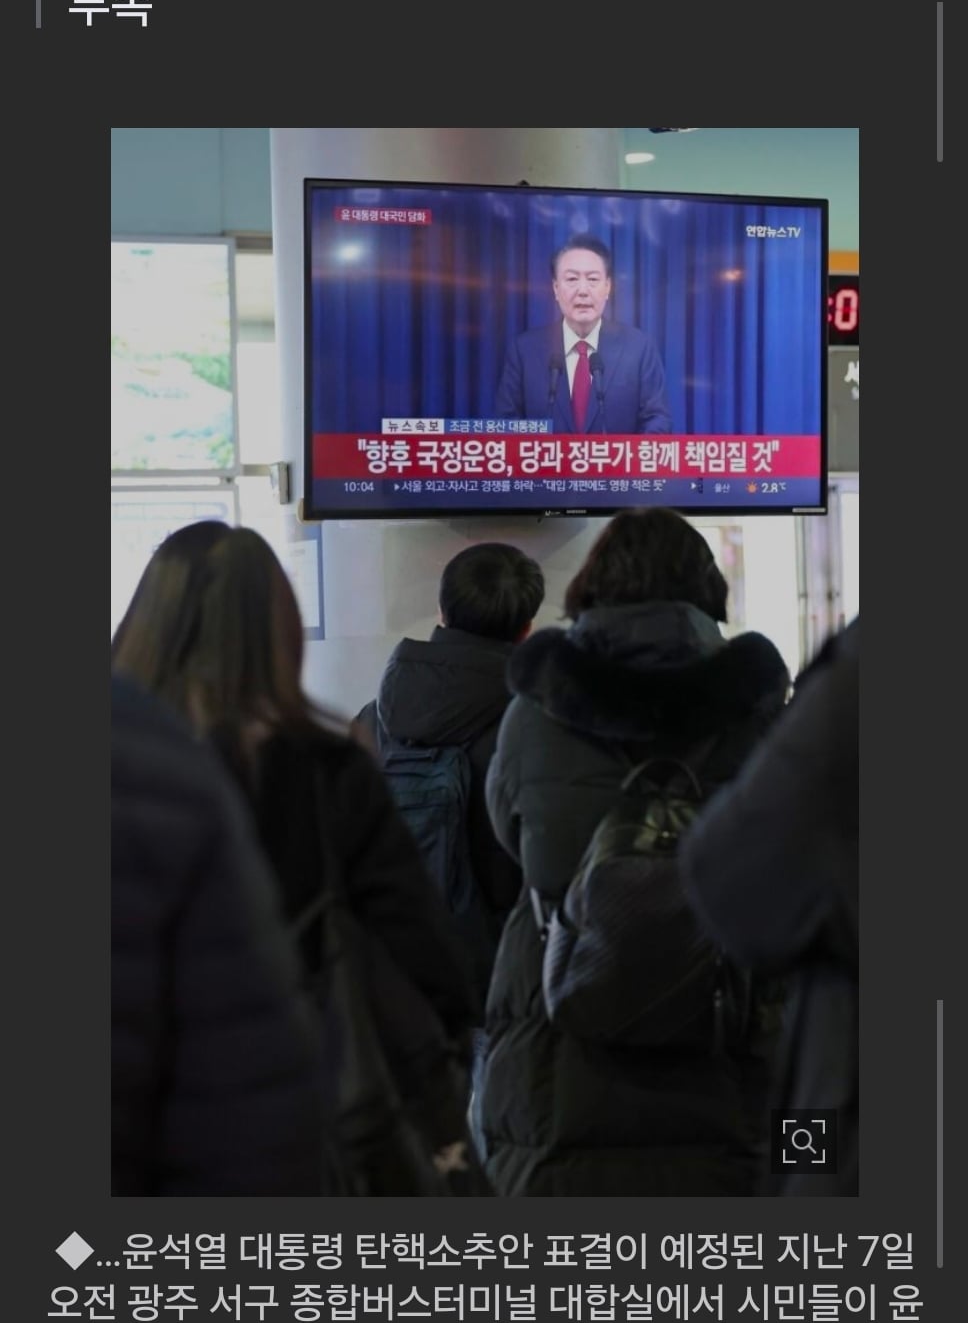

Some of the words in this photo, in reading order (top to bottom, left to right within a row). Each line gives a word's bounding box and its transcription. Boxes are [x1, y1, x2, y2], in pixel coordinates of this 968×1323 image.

[341, 209, 351, 221] 윤
[352, 210, 378, 222] 대통령
[380, 210, 407, 222] 대국민
[408, 211, 426, 223] 담화
[746, 225, 801, 238] 연합뉴스TV
[450, 420, 470, 433] 조금
[472, 420, 483, 433] 전
[486, 420, 506, 433] 용산
[508, 420, 548, 433] 대통령실
[357, 438, 412, 474] "향후
[416, 440, 513, 477] 국정운영,
[519, 440, 563, 474] 당과
[568, 440, 633, 473] 정부가
[638, 440, 680, 473] 함께
[685, 440, 747, 473] 책임질
[752, 439, 780, 473] 것"
[344, 481, 374, 493] 10:04
[401, 480, 422, 493] 서울
[481, 480, 511, 493] 경쟁률
[568, 479, 607, 492] 개편에도
[609, 479, 629, 492] 영향
[631, 479, 650, 492] 적은
[240, 1233, 342, 1270] 대통령
[357, 1233, 534, 1270] 탄핵소추안
[544, 1233, 646, 1269] 표결이
[661, 1233, 763, 1270] 예정된
[777, 1233, 847, 1269] 지난
[858, 1233, 913, 1269] 7일
[48, 1284, 115, 1320] 오전
[128, 1284, 198, 1321] 광주
[210, 1284, 279, 1321] 서구
[290, 1284, 536, 1321] 종합버스터미널
[550, 1284, 723, 1321] 대합실에서
[738, 1284, 875, 1321] 시민들이
[889, 1285, 923, 1320] 윤
